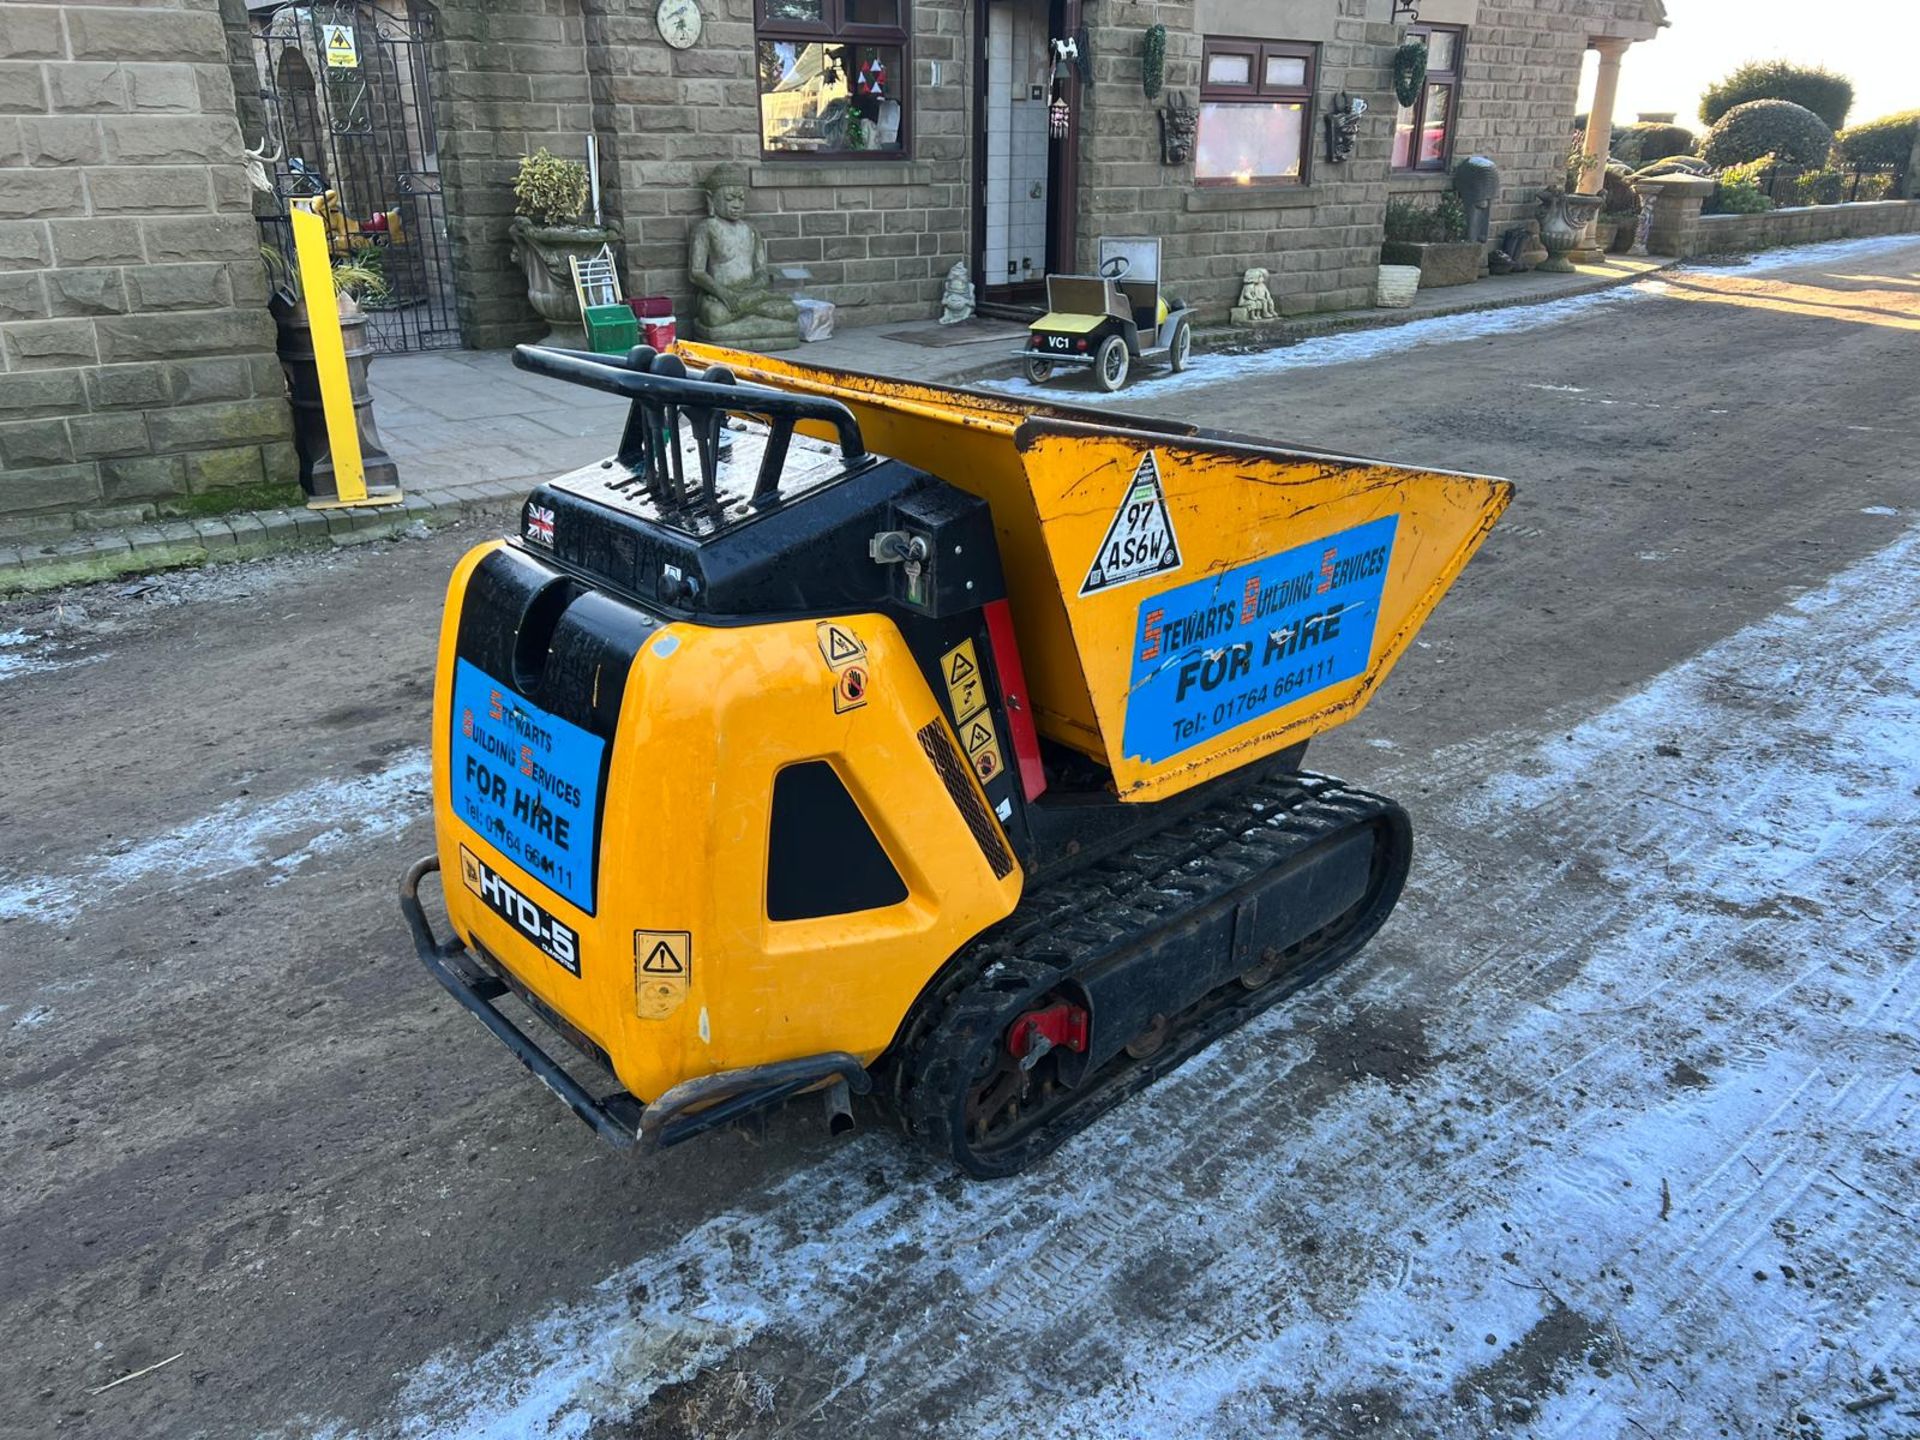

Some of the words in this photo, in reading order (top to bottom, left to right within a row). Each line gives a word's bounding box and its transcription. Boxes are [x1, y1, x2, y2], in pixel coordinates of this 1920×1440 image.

[1048, 335, 1069, 349] VC1
[1106, 529, 1164, 573] AS6W
[1127, 501, 1154, 535] 97
[1142, 600, 1236, 662] STEWARTS
[1240, 570, 1314, 625] BUILDING
[1317, 545, 1386, 595] SERVICES
[1175, 641, 1254, 703] FOR
[1262, 603, 1345, 667] HIRE
[489, 690, 553, 752] STEWARTS
[1173, 714, 1207, 743] Tel:
[1213, 684, 1268, 725] 01764
[1273, 656, 1334, 698] 664111
[463, 709, 516, 768] BUILDING
[520, 744, 581, 809] SERVICES
[465, 796, 482, 826] Tel:
[466, 754, 507, 809] FOR
[513, 787, 570, 852] HIRE
[480, 863, 575, 962] HTD-5
